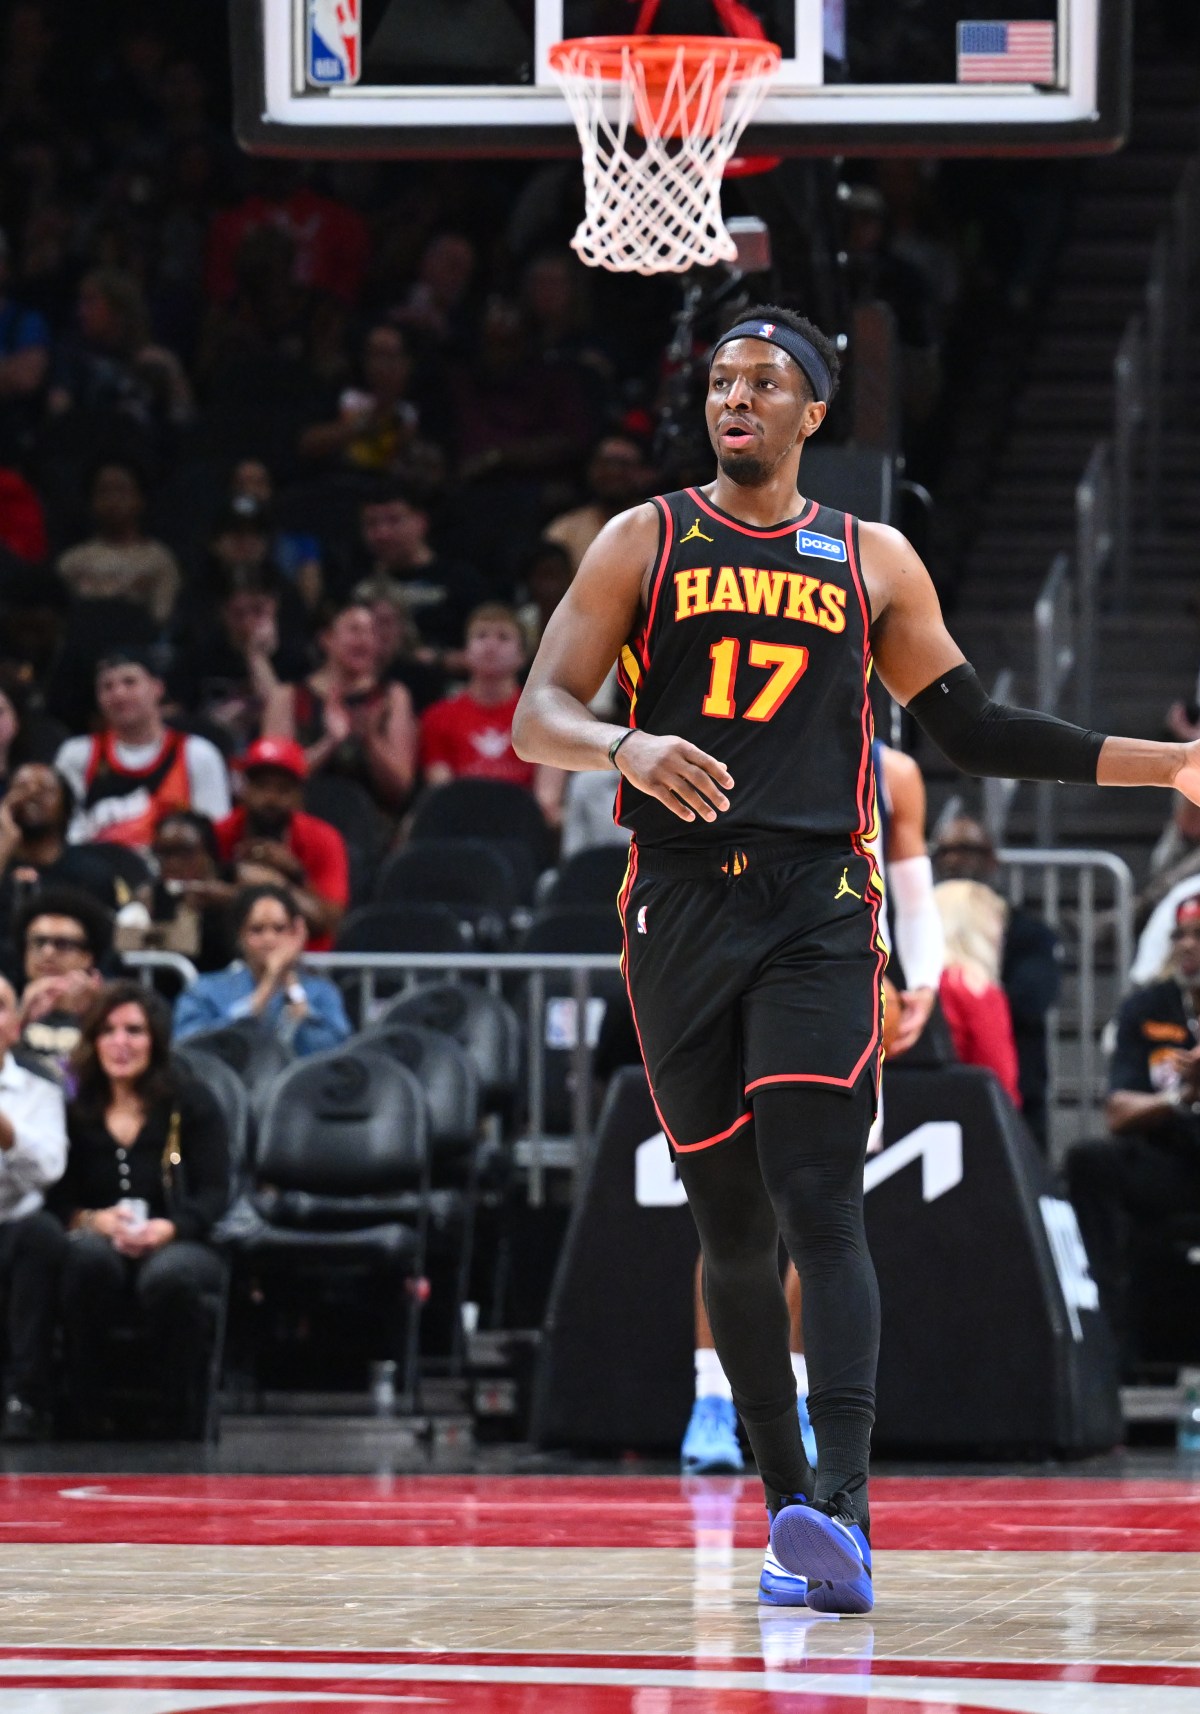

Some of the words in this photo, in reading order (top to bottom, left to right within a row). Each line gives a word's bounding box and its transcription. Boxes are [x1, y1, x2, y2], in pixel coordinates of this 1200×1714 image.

[802, 537, 841, 554] paze
[674, 567, 847, 634] HAWKS
[702, 637, 809, 722] 17
